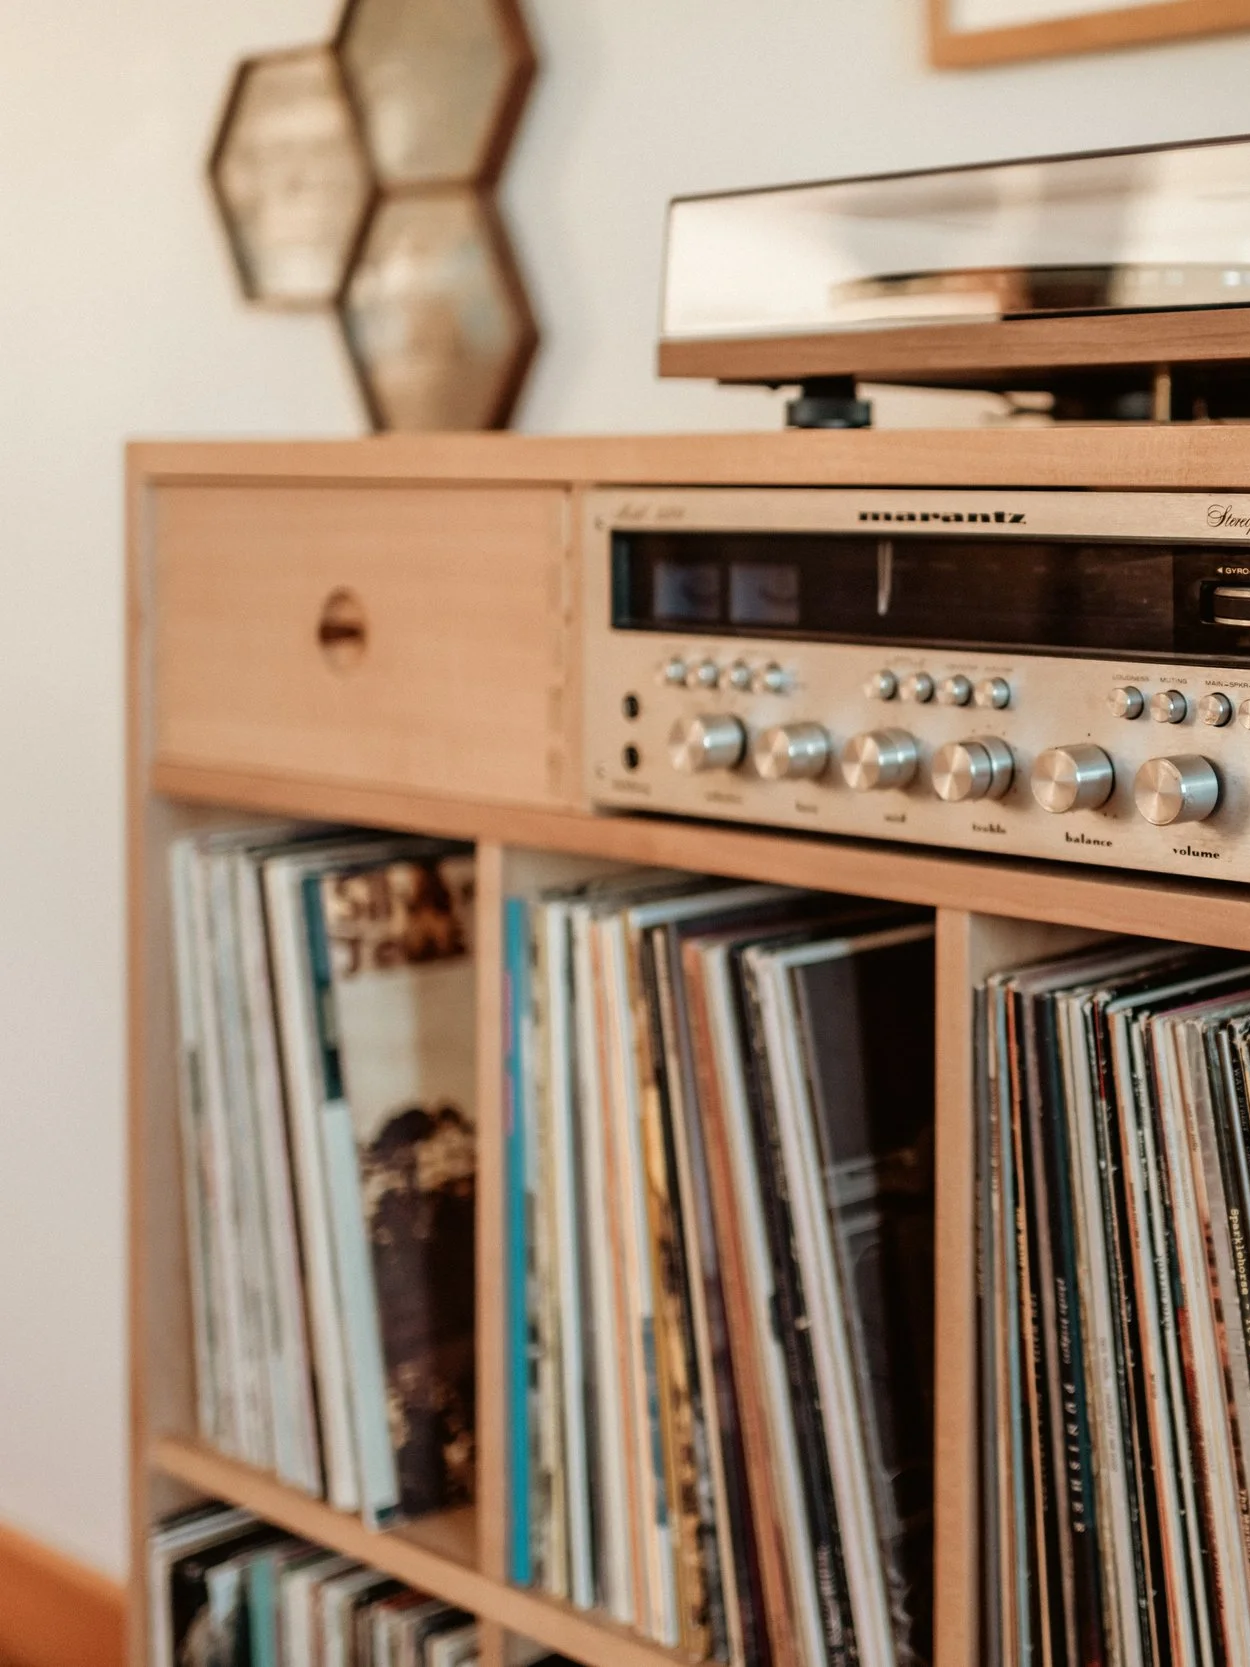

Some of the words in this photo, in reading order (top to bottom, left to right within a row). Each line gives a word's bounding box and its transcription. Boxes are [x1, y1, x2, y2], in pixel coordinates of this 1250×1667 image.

[860, 511, 1027, 525] marantz
[1160, 677, 1187, 685] MUTING
[1065, 831, 1113, 848] balance
[1172, 847, 1221, 861] volume
[1230, 1208, 1249, 1296] Sparklehorse
